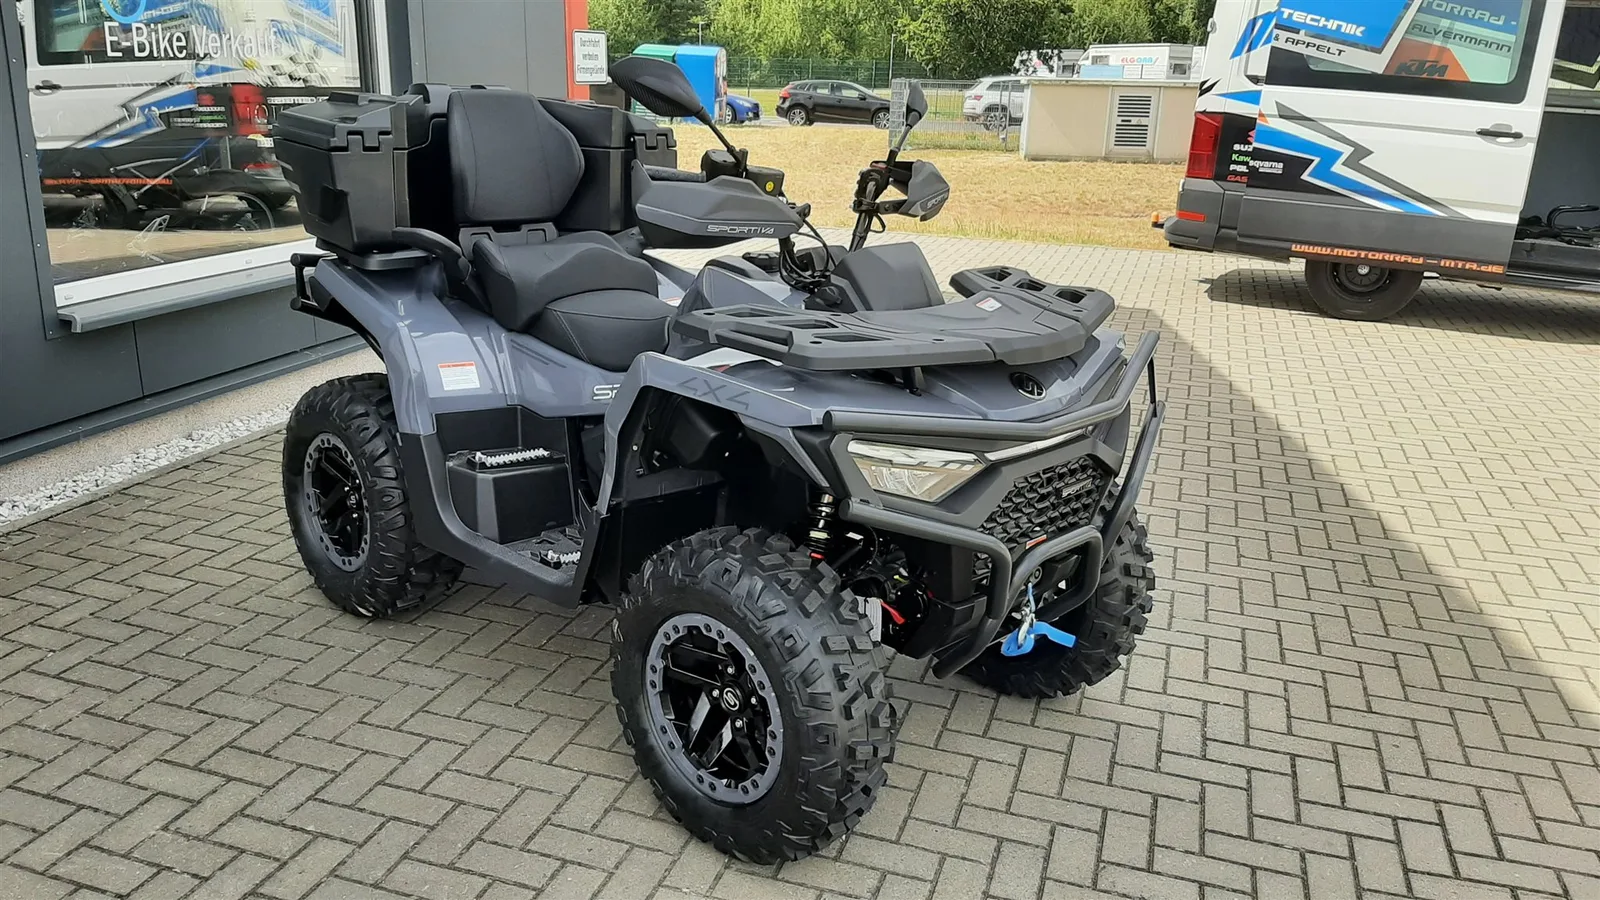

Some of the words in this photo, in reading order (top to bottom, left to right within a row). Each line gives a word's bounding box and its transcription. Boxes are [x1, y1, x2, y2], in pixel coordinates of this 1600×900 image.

[1280, 7, 1366, 37] TECHNIK
[103, 21, 187, 58] E-Bike
[191, 25, 279, 59] Verkauf
[1273, 33, 1280, 42] &
[1284, 36, 1346, 57] APPELT
[1411, 22, 1512, 53] ALVERMANN
[1395, 59, 1449, 78] KTM
[706, 224, 775, 235] SPORTIVA
